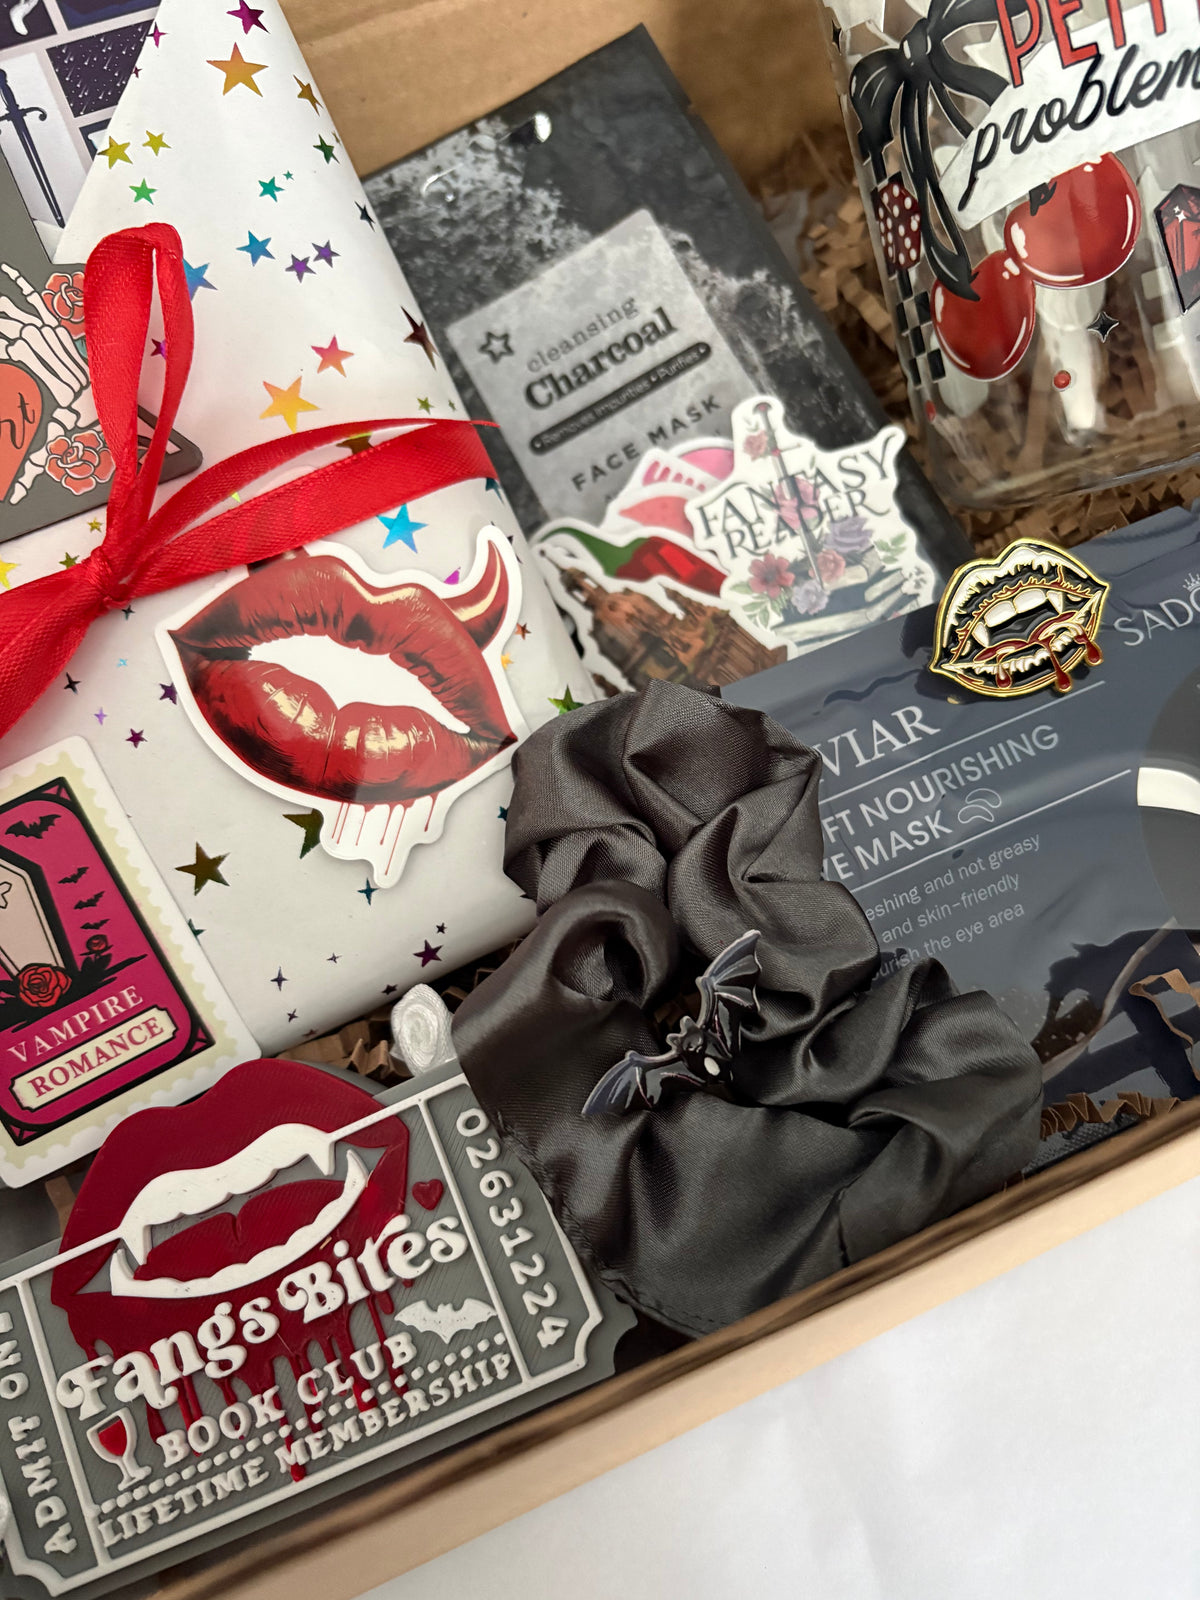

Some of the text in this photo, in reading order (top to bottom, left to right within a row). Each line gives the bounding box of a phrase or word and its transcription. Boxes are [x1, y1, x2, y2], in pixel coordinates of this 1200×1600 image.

[524, 306, 678, 410] Charcoal
[527, 297, 639, 372] cleansing
[541, 350, 700, 447] Removes Impurities Purifies
[571, 395, 722, 492] FACE MASK
[698, 433, 897, 540] FANTASY
[724, 488, 890, 558] READER
[813, 706, 941, 778] VIAR
[859, 725, 1060, 828] NOURISHING
[854, 810, 953, 871] MASK
[923, 869, 955, 894] and
[958, 857, 987, 880] not
[988, 832, 1041, 870] greasy
[881, 873, 1019, 943] and skin-friendly
[923, 934, 952, 957] the
[955, 921, 984, 943] eye
[987, 902, 1025, 929] area
[8, 985, 143, 1063] VAMPIRE
[27, 1016, 164, 1097] ROMANCE
[456, 1107, 569, 1349] 02631224
[56, 1214, 468, 1421] Fangs Bites
[156, 1331, 417, 1468] BOOK CLUB
[8, 1415, 77, 1554] ADMIT
[99, 1353, 512, 1548] LIFETIME MEMBERSHIP
